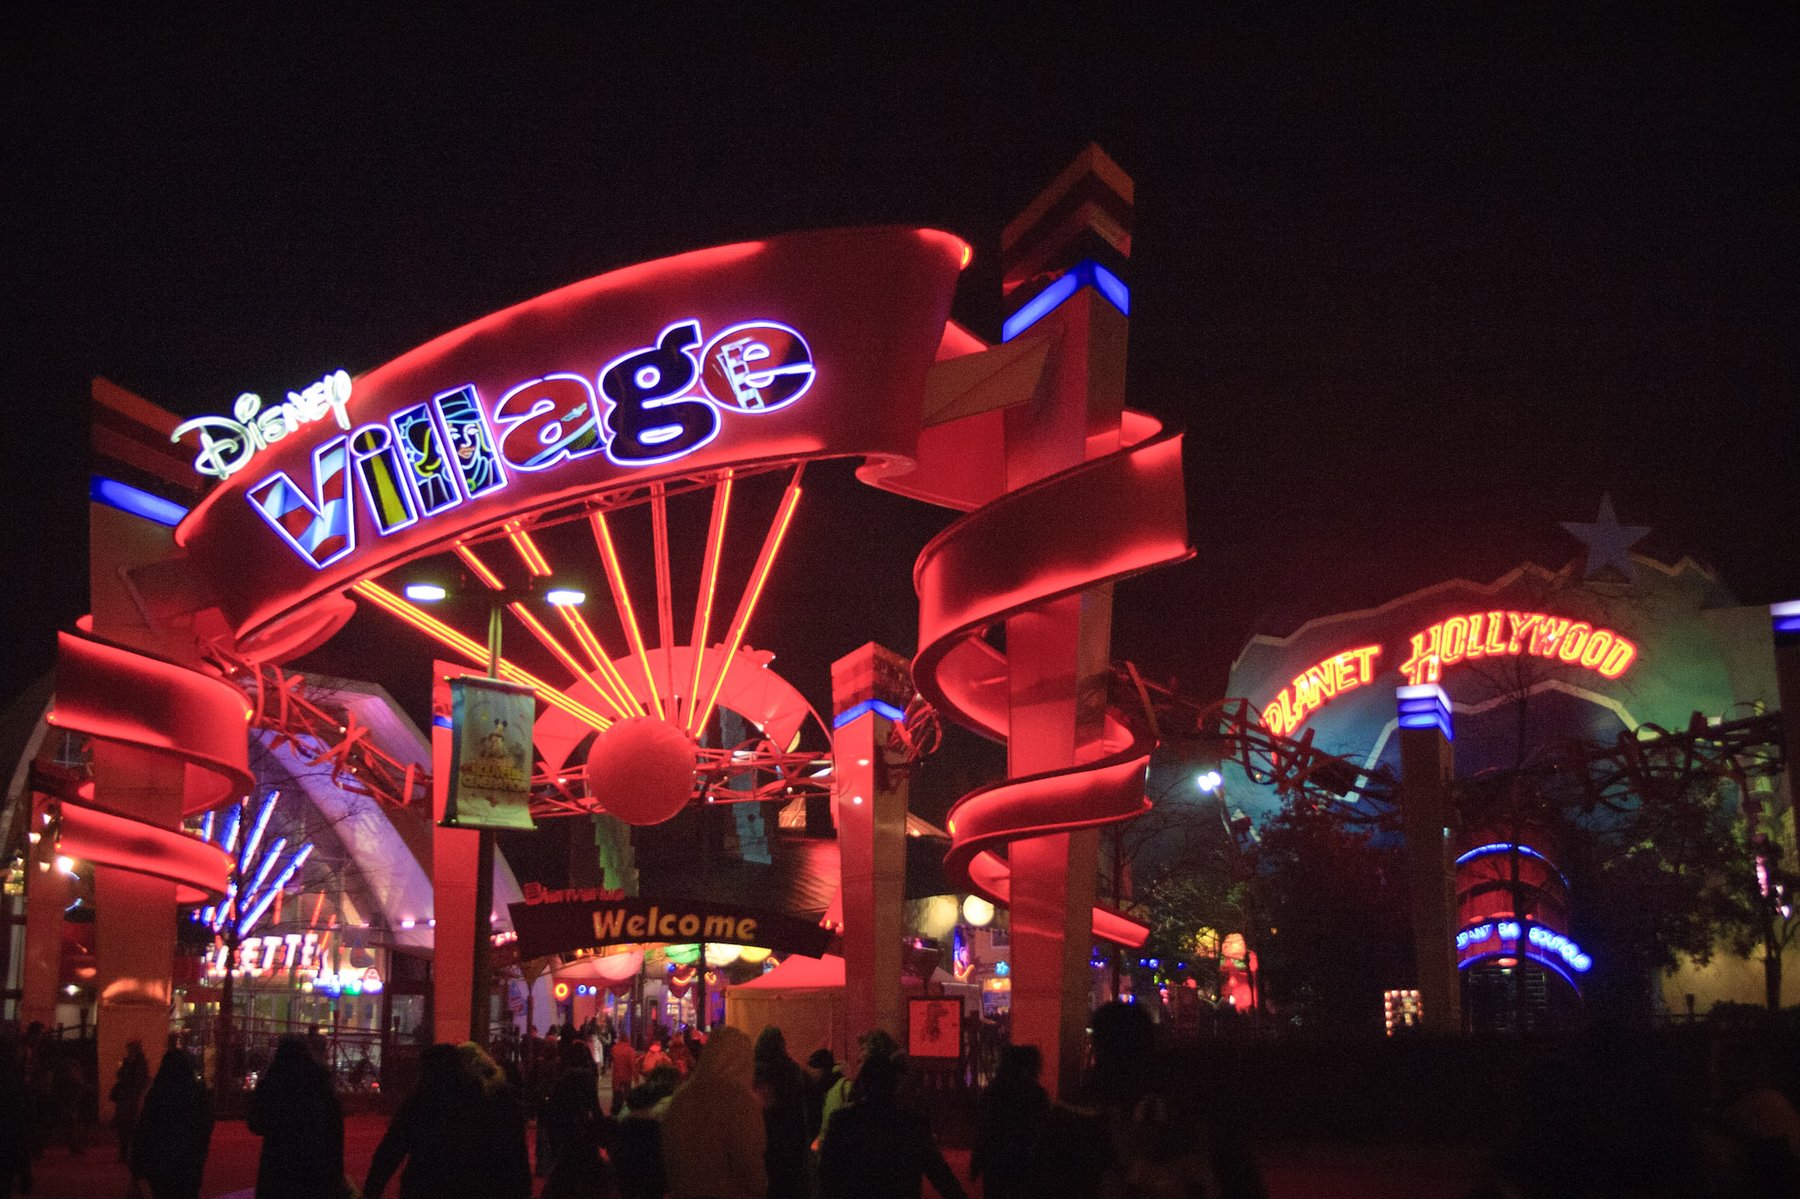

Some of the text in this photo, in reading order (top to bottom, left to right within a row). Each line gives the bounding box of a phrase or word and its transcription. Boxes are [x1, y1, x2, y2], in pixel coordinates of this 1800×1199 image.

[246, 319, 818, 570] Village
[1258, 611, 1636, 737] PLANET HOLLYWOOD
[592, 906, 758, 939] Welcome
